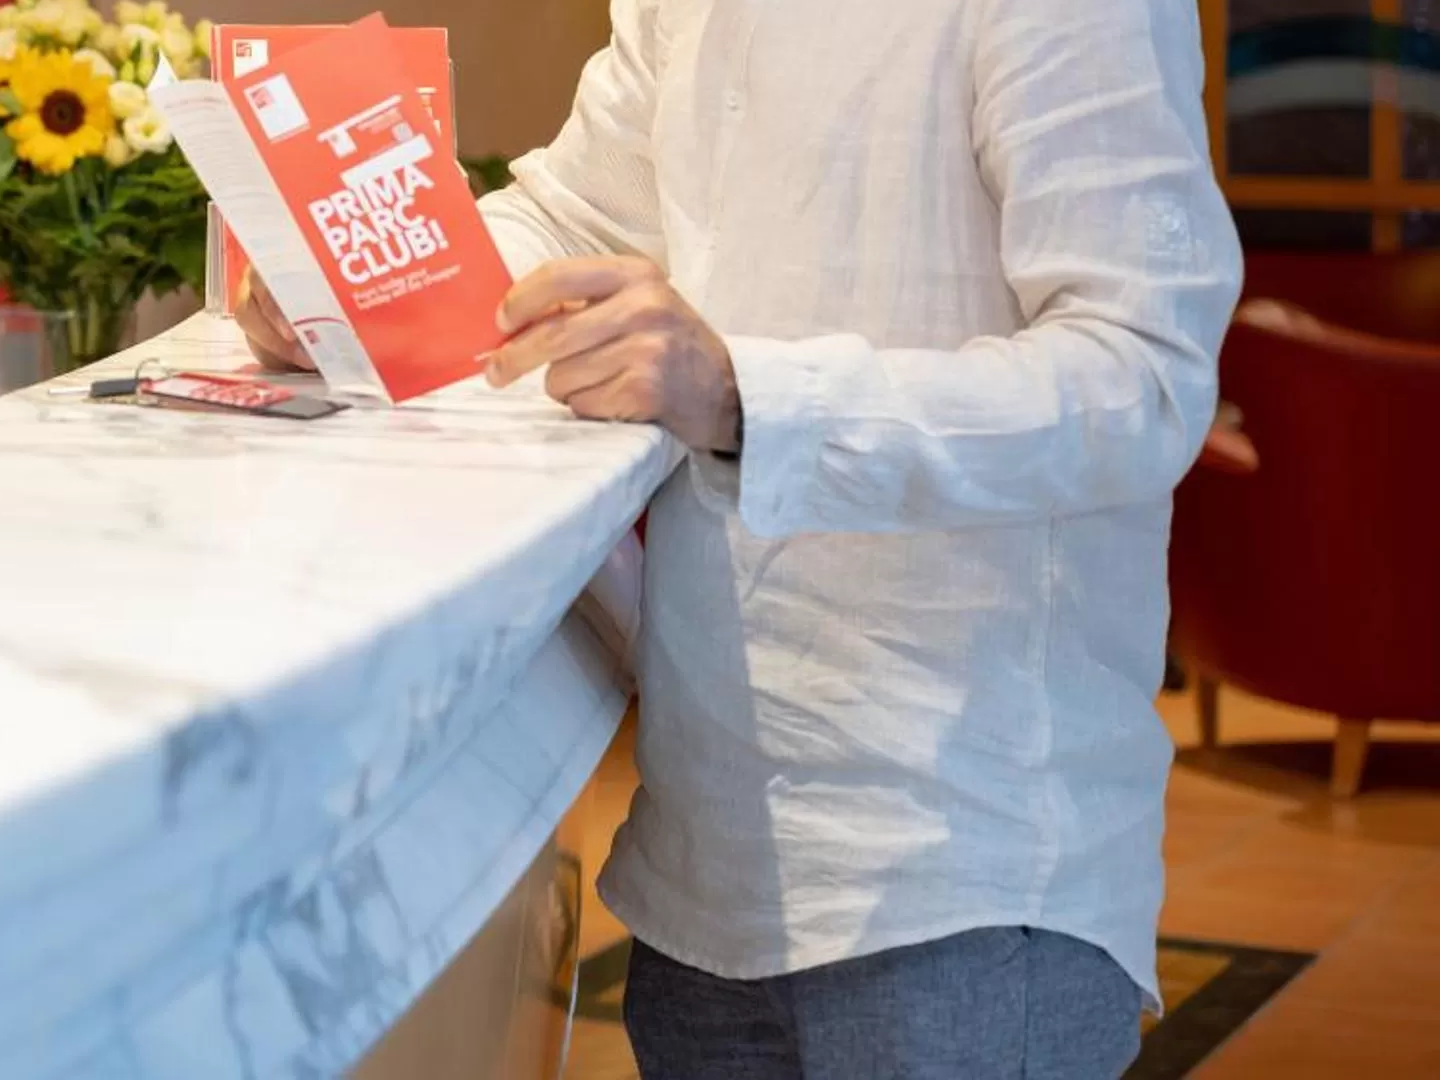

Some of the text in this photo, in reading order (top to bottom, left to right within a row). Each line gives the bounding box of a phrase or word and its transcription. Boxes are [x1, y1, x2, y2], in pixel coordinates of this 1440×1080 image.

[308, 163, 435, 230] PRIMA
[323, 196, 425, 260] PARC
[338, 226, 449, 285] CLUB!
